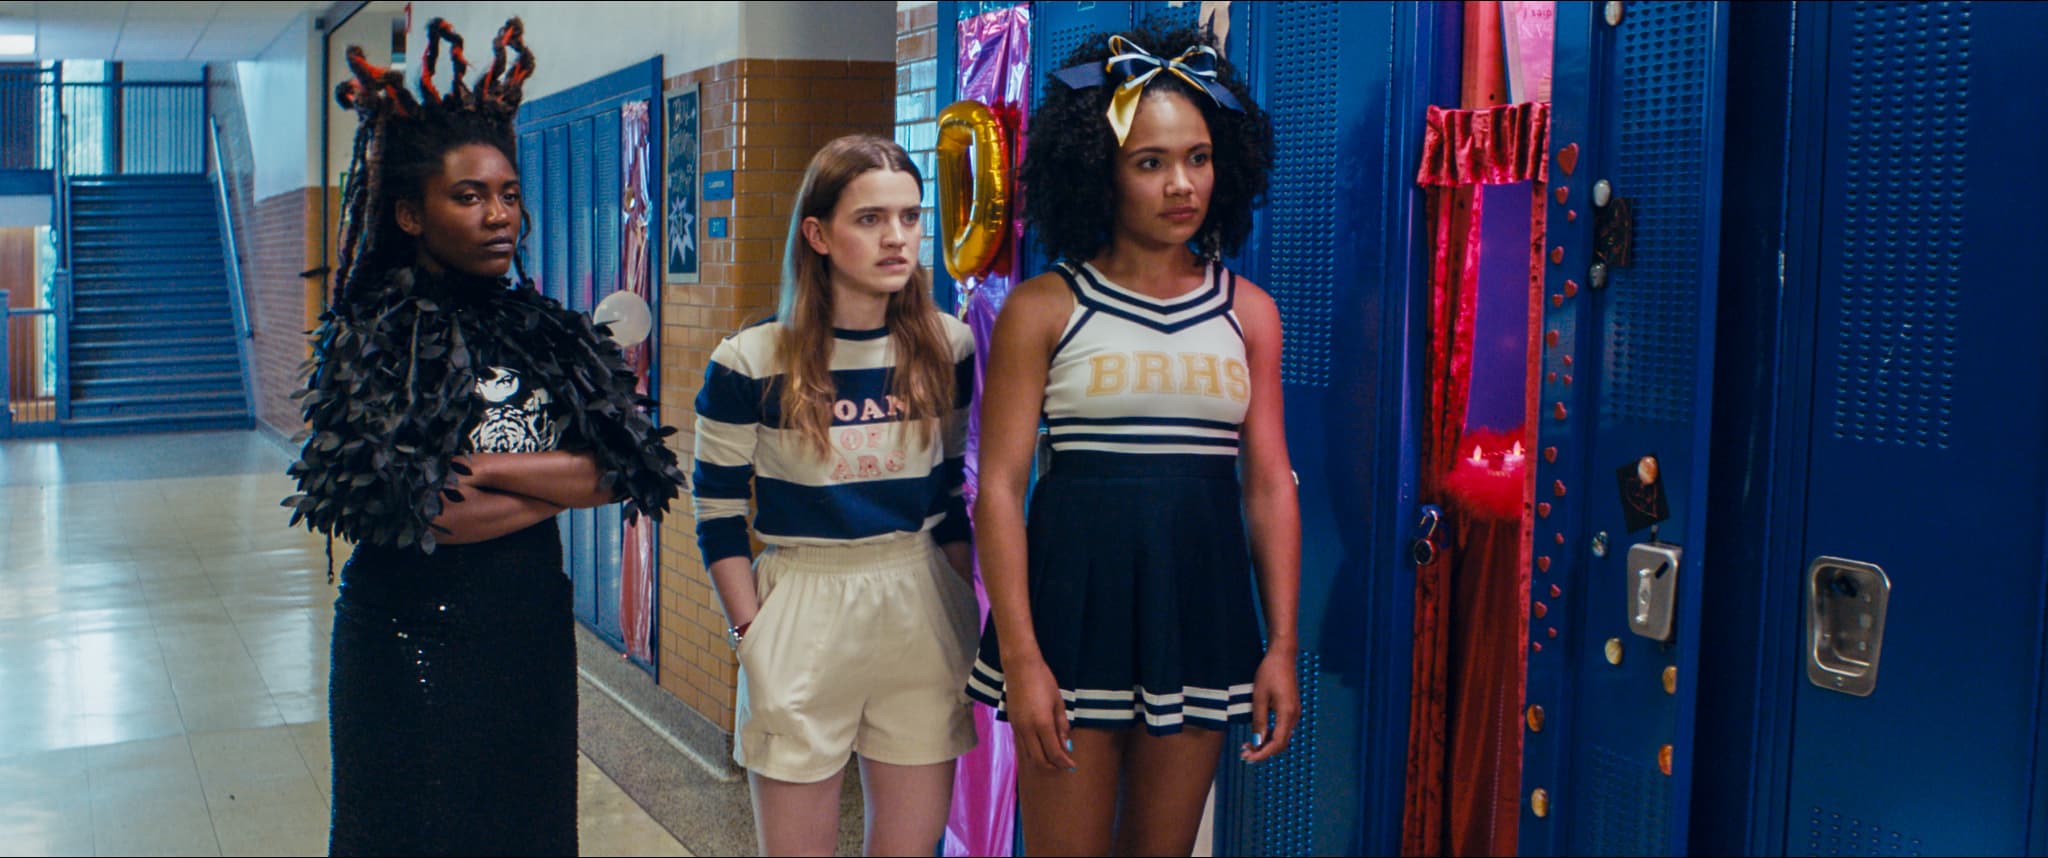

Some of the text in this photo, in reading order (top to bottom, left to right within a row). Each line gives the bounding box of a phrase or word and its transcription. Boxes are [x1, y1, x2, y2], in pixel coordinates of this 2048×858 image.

[1085, 351, 1250, 404] BRHS
[833, 394, 910, 422] OAN
[840, 424, 884, 450] OF
[831, 450, 906, 481] ARC
